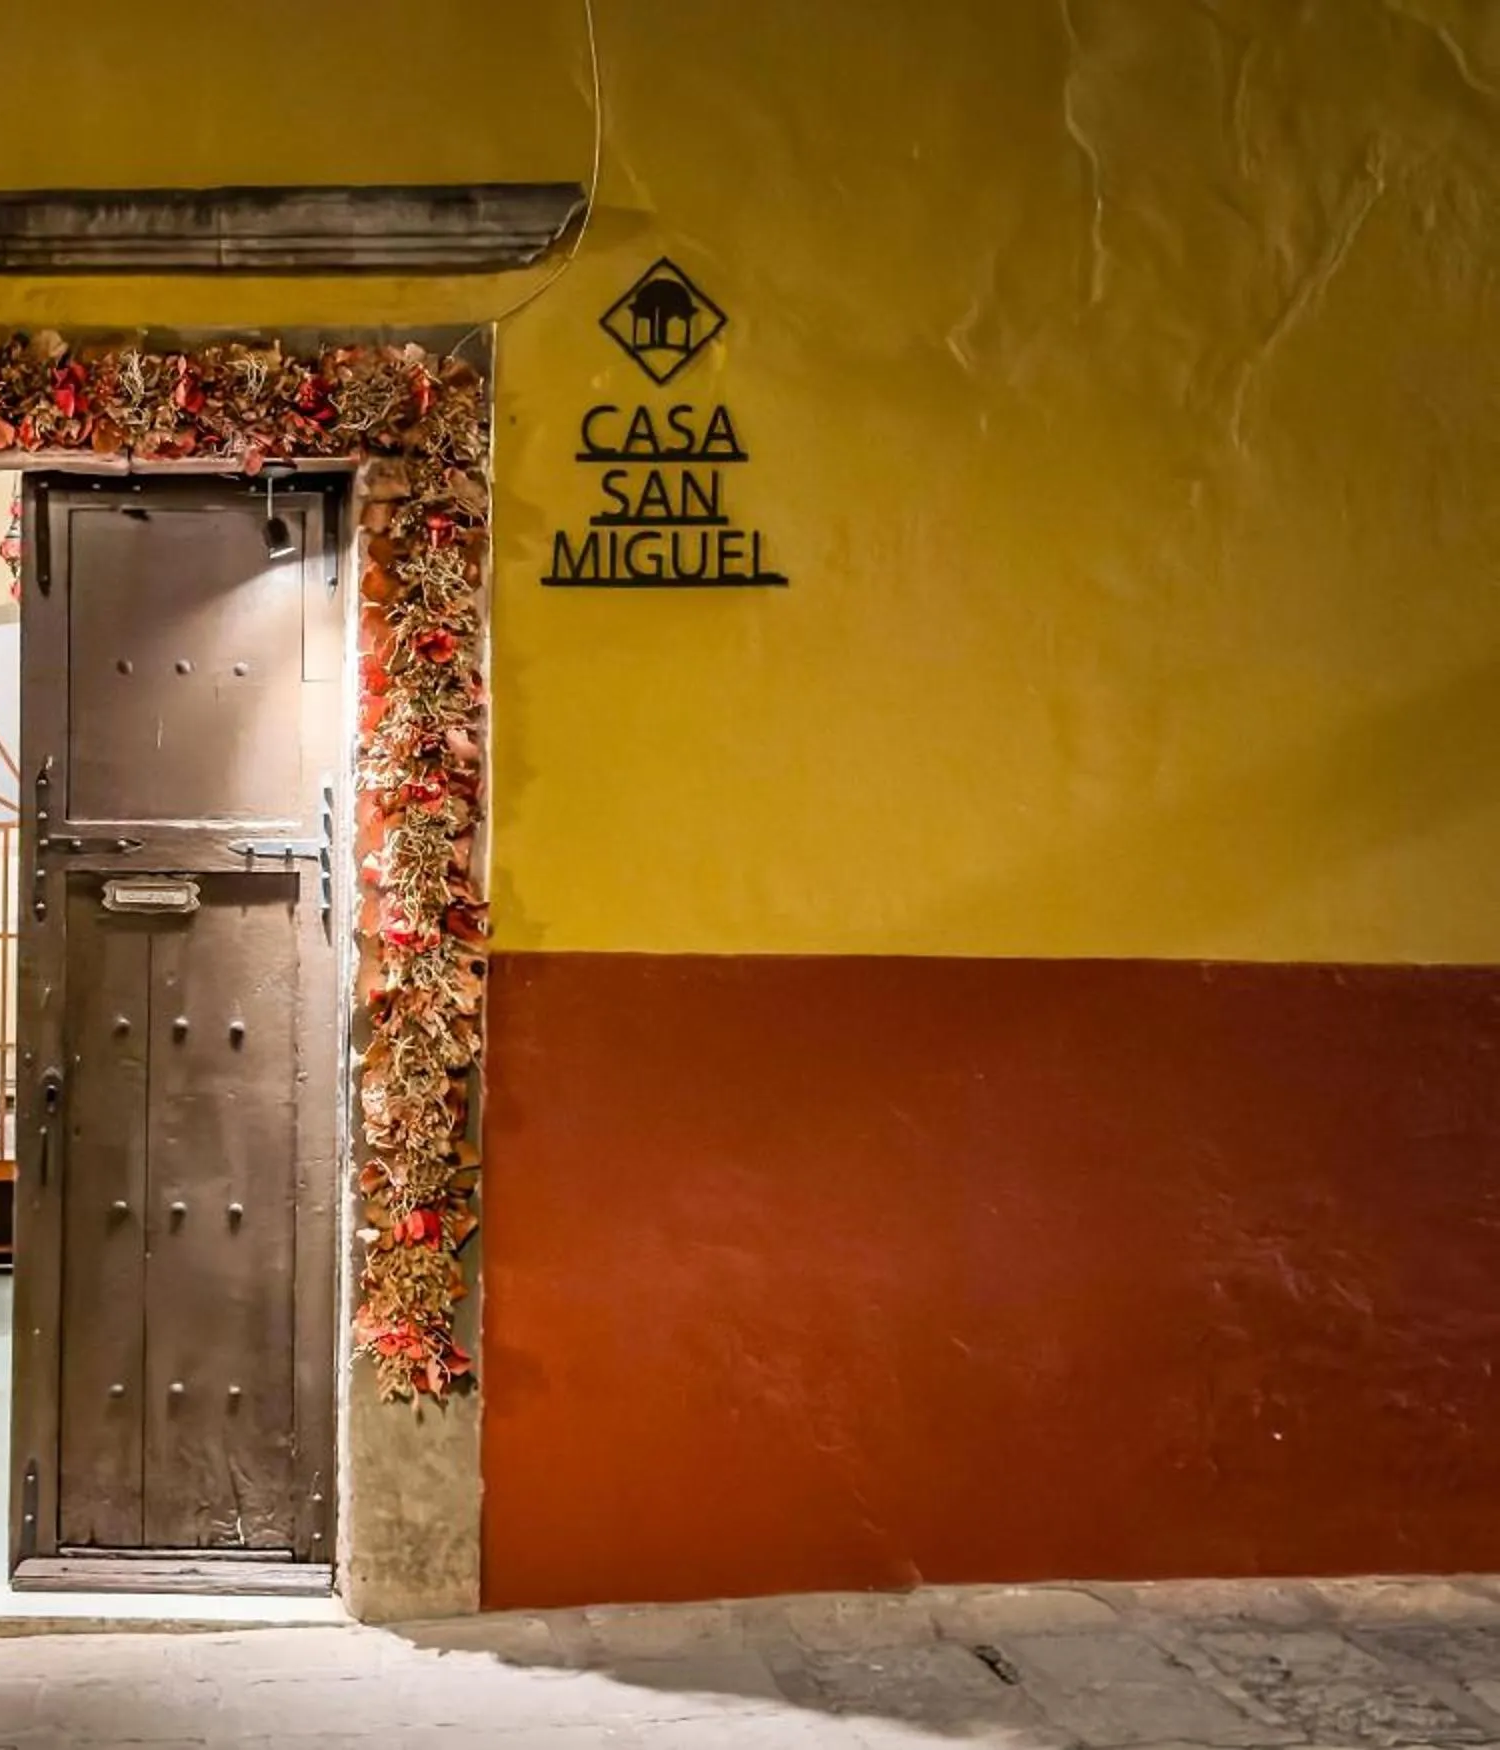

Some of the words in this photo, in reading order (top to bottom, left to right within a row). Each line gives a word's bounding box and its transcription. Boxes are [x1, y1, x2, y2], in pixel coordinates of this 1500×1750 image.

[580, 404, 741, 454] CASA
[601, 469, 719, 518] SAN
[552, 530, 785, 579] MIGUEL
